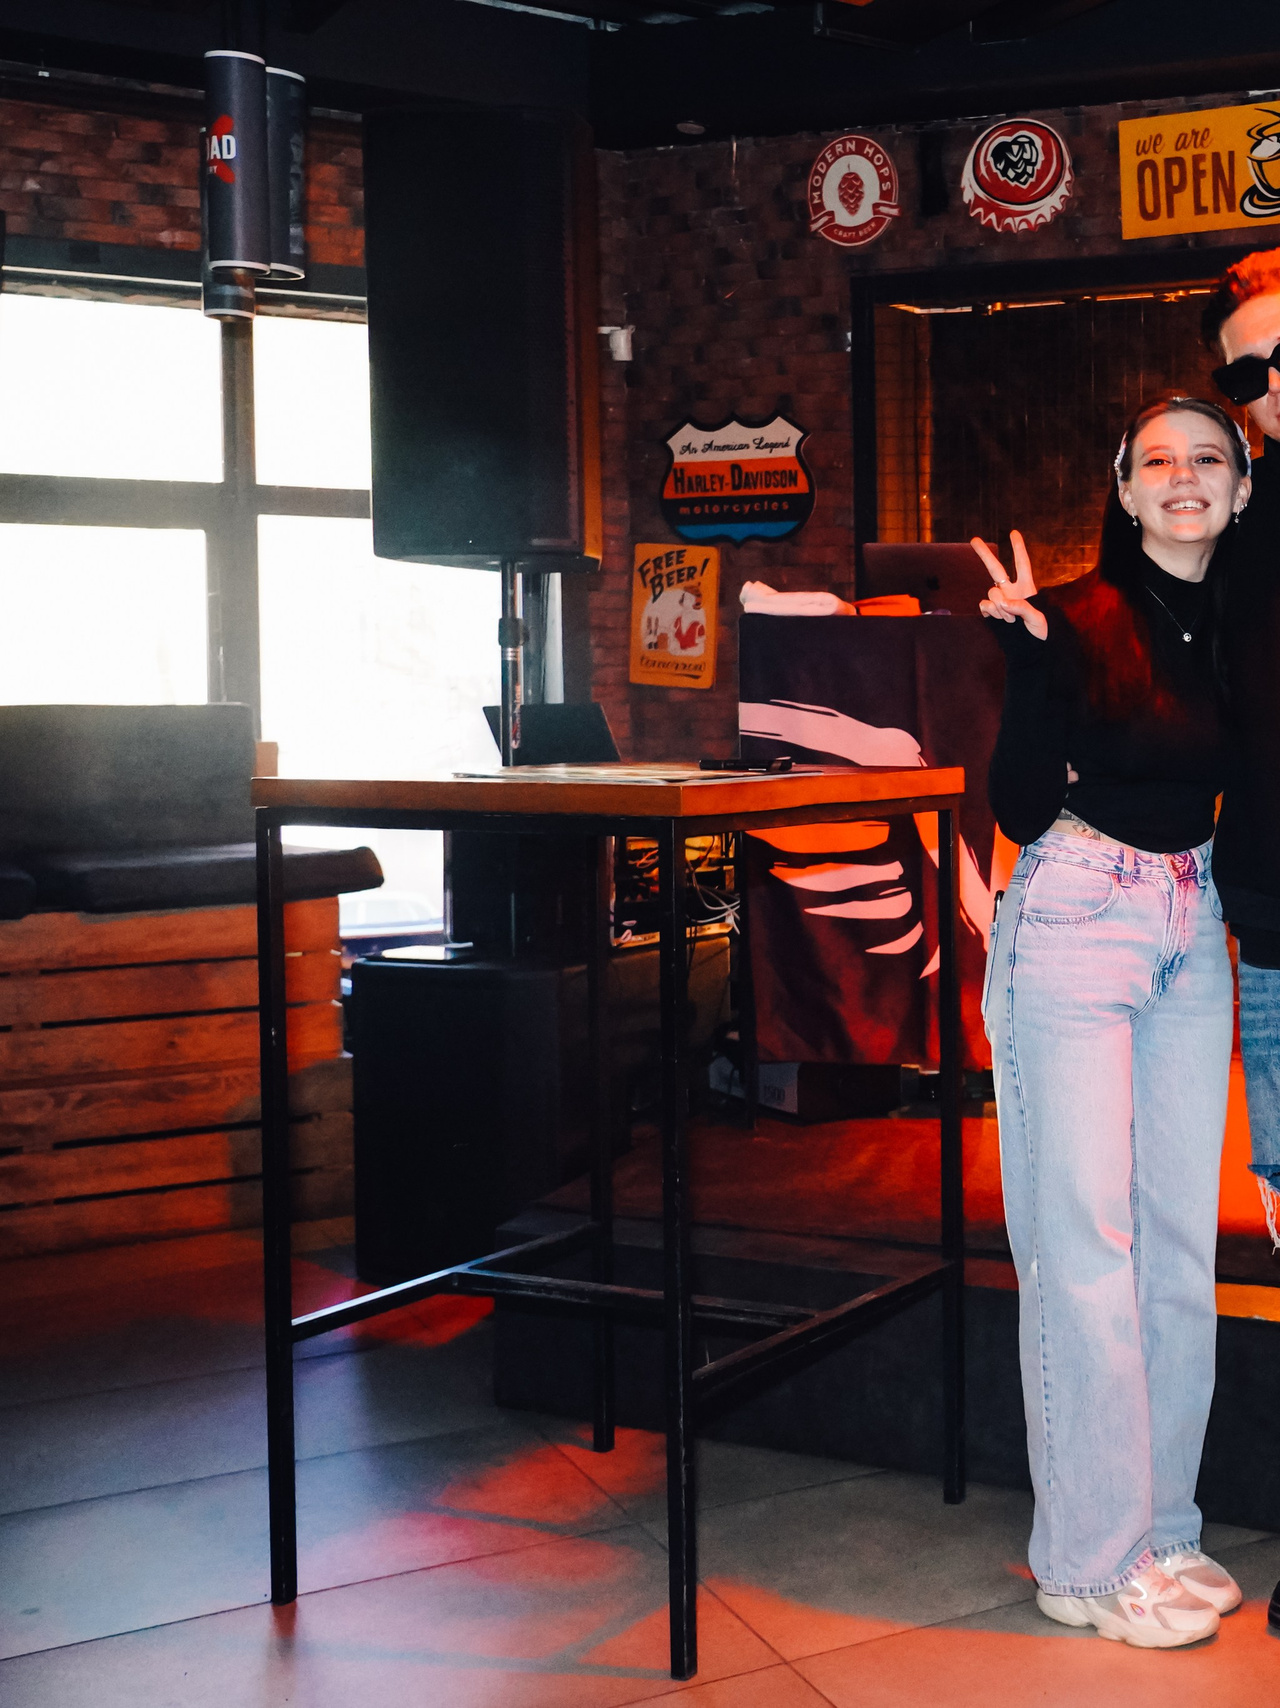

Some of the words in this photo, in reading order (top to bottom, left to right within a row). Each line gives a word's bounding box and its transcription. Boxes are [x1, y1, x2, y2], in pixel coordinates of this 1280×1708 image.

[1136, 133, 1165, 156] we
[1175, 127, 1213, 151] are
[811, 140, 856, 204] MODERN
[864, 144, 891, 191] HOPS
[1137, 150, 1236, 221] OPEN
[833, 228, 856, 238] CRAFT
[859, 222, 876, 236] BEER
[680, 442, 698, 455] An
[701, 440, 750, 453] American
[752, 437, 791, 453] Legend
[679, 500, 790, 515] motorcycles
[637, 549, 687, 588] FREE
[649, 558, 710, 604] BEER!
